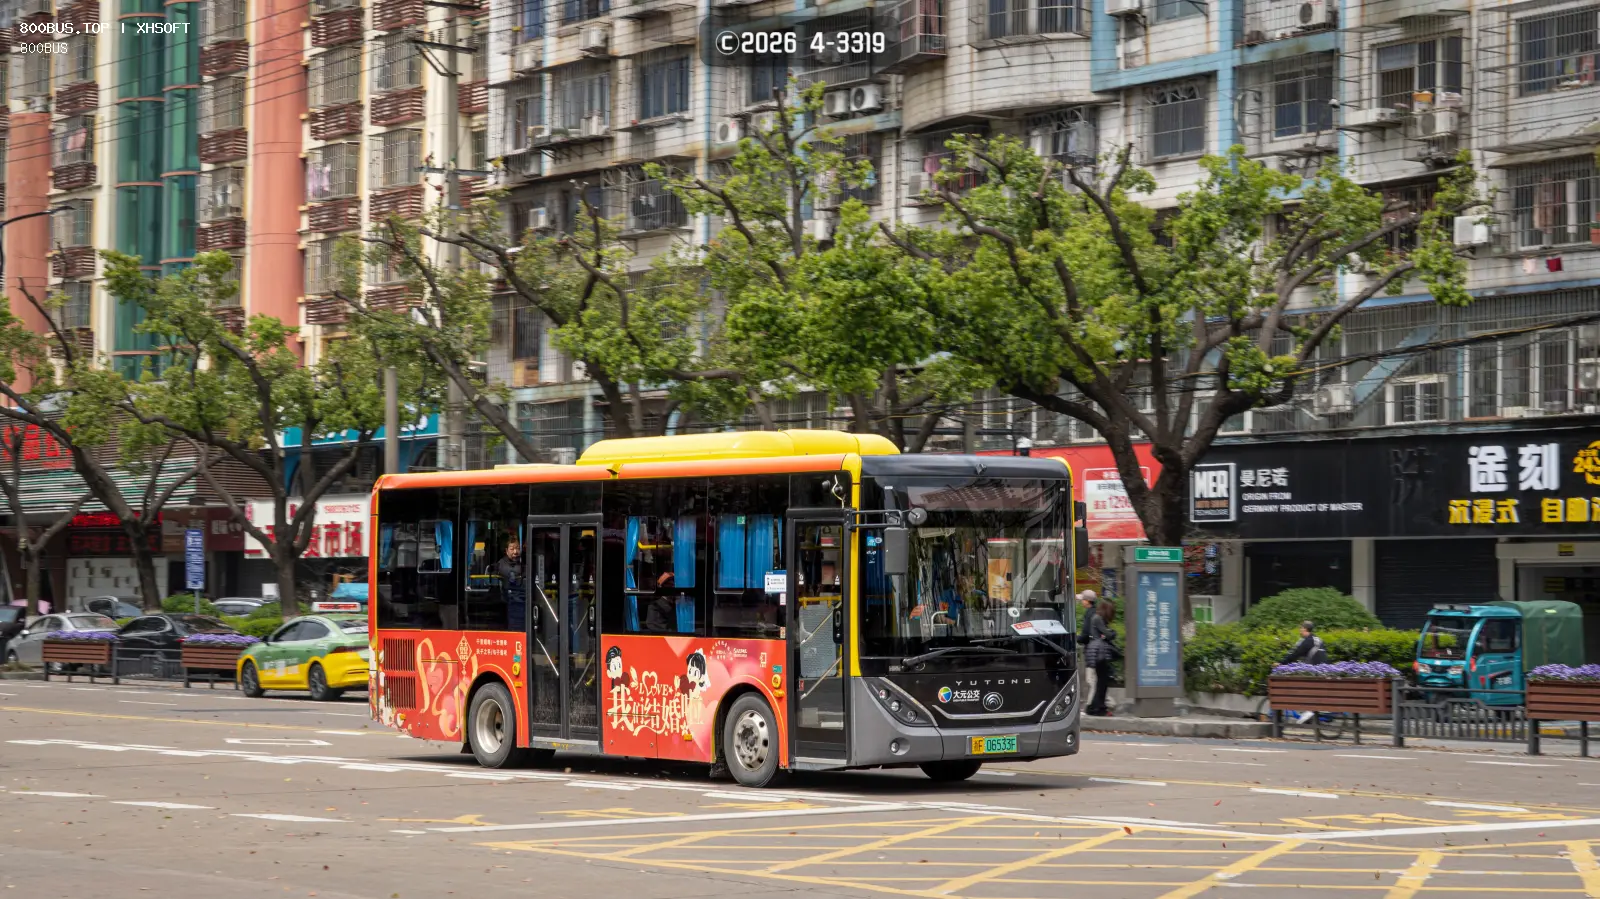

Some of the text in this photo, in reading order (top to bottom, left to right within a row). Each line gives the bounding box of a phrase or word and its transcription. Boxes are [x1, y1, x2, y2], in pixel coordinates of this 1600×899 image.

[1240, 467, 1289, 487] 曼尼诺
[1194, 470, 1229, 498] MER
[1242, 492, 1292, 501] ORIGIN FROM
[1242, 502, 1363, 513] GERMANY PRODUCT OF MASTER
[1448, 498, 1519, 524] 沉浸式
[956, 678, 1031, 686] YUTONG
[953, 689, 981, 699] 大元公交
[986, 738, 1016, 752] 06533F
